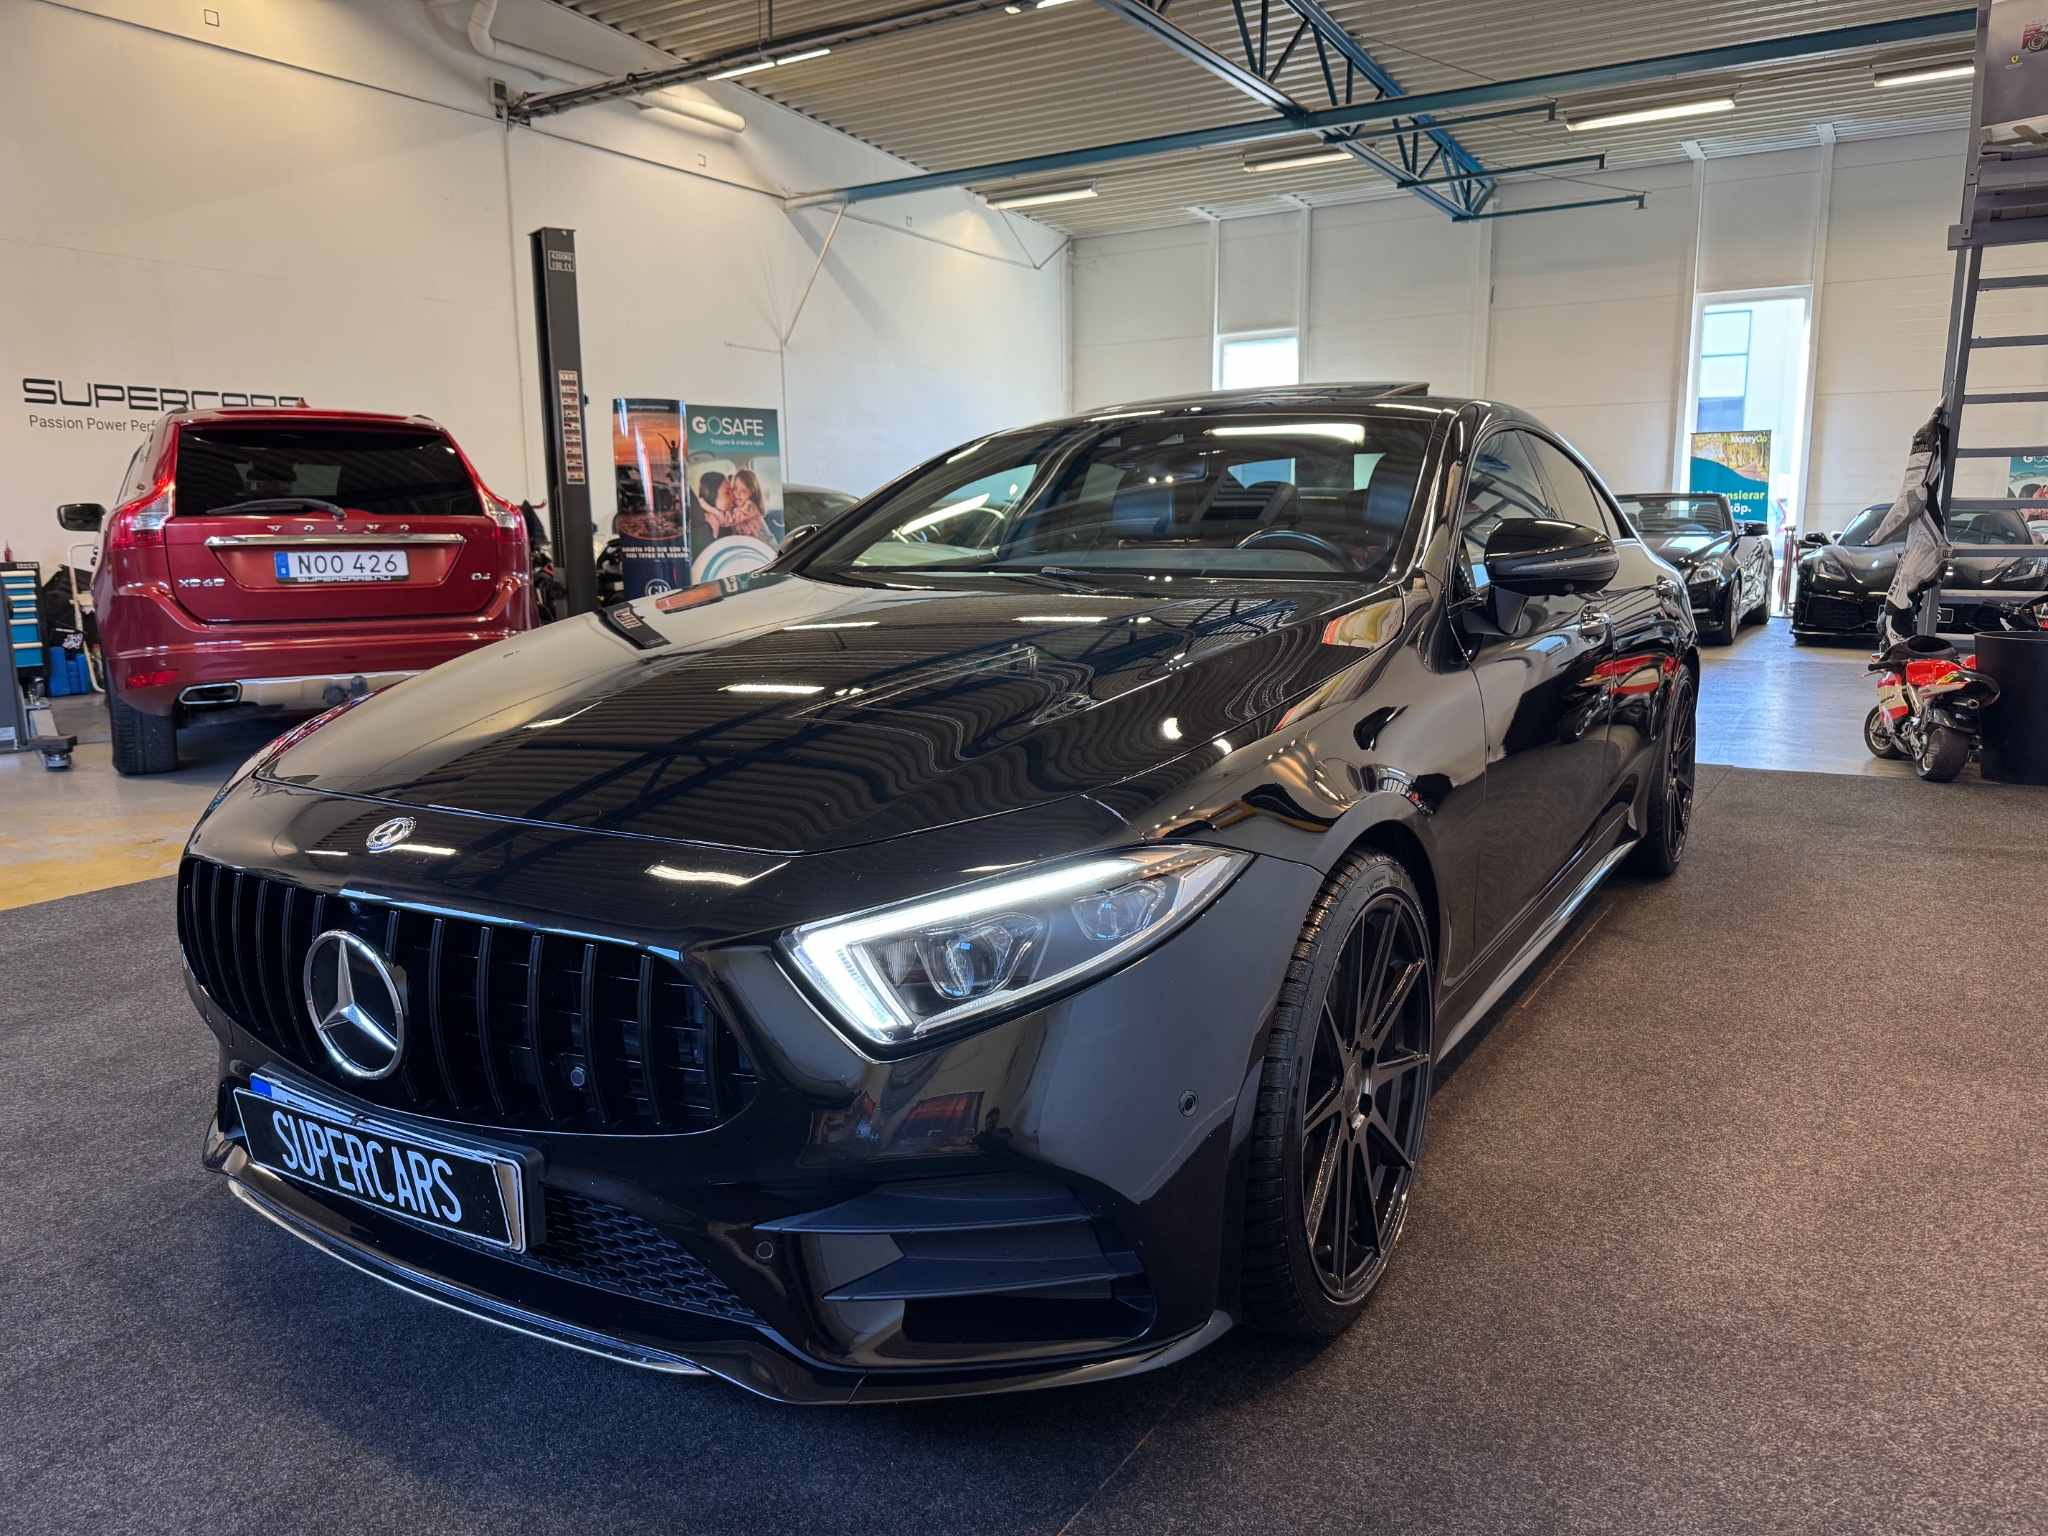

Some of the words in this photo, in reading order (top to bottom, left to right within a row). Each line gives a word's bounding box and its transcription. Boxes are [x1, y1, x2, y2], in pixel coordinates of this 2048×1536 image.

[29, 414, 83, 429] Passion
[87, 417, 127, 431] Power
[691, 416, 764, 437] GOSAFE
[1730, 435, 1768, 444] MoneyGo
[267, 524, 410, 532] VOLVO
[297, 554, 344, 574] NOO
[353, 554, 397, 573] 426
[178, 578, 225, 587] XC60
[272, 1110, 462, 1223] SUPERCARS
